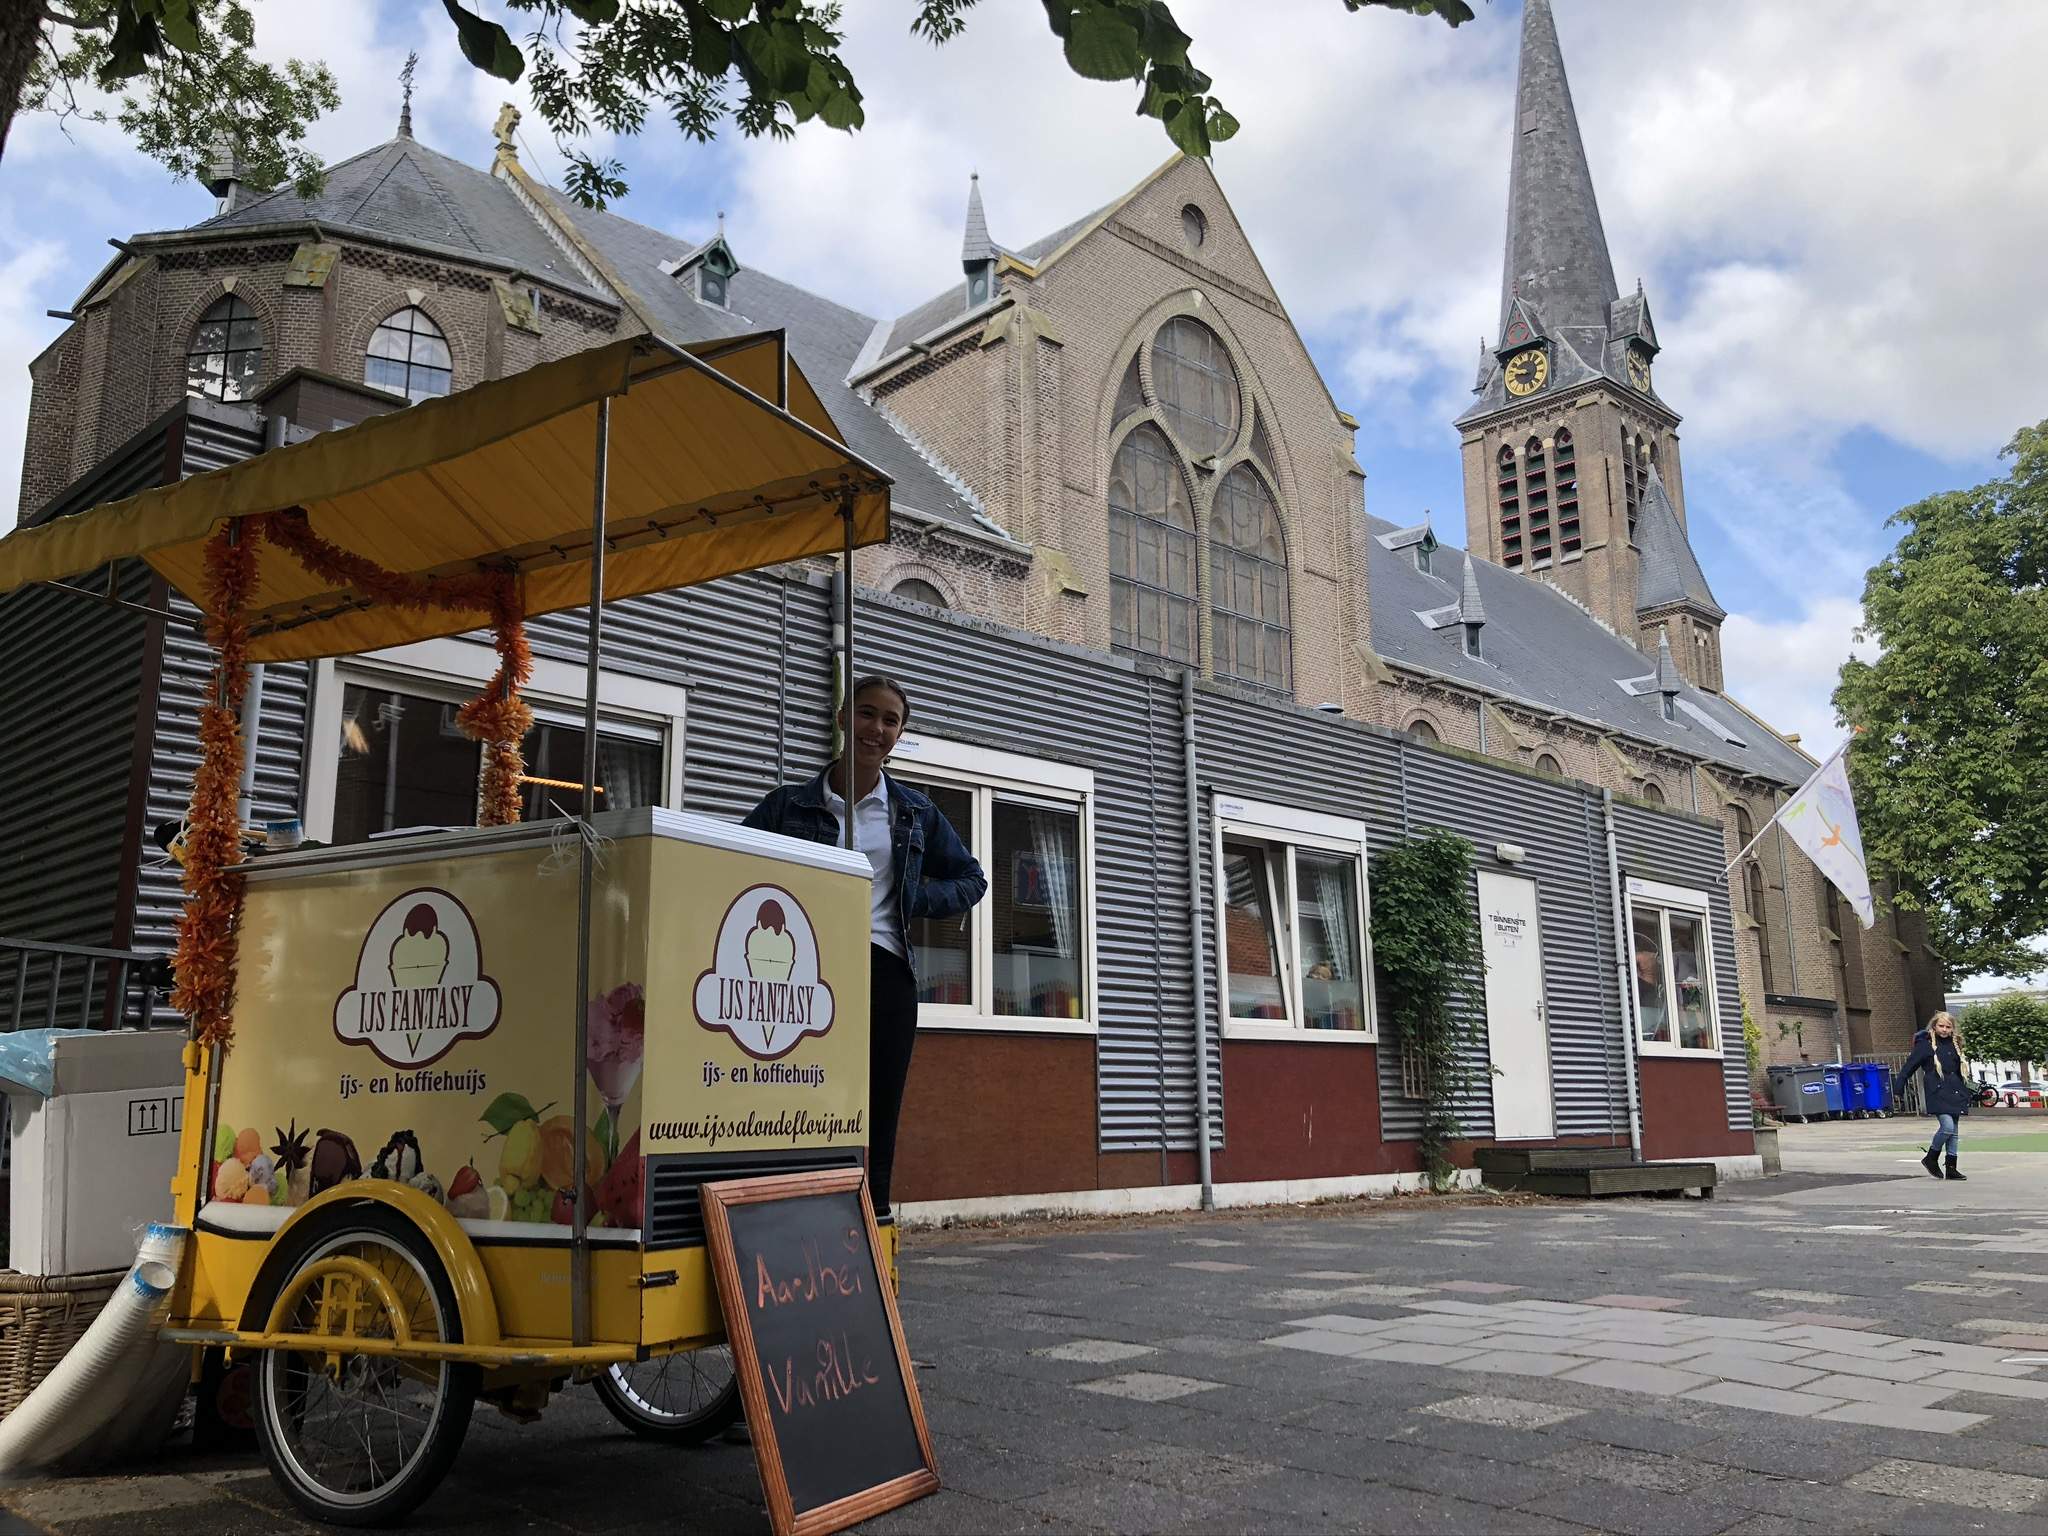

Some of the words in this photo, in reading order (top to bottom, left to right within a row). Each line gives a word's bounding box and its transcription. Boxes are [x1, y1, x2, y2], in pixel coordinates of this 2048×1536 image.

[1494, 915, 1526, 926] BINNENSTE
[1498, 924, 1519, 933] BUITEN
[358, 991, 386, 1033] IJS
[390, 985, 474, 1031] FANTASY
[718, 977, 743, 1020] IJS
[747, 980, 815, 1025] FANTASY
[340, 1074, 363, 1099] ijs-
[369, 1076, 389, 1093] en
[394, 1069, 486, 1095] koffiehuijs
[703, 1061, 726, 1087] ijs-
[730, 1065, 748, 1083] en
[753, 1063, 825, 1088] koffiehuijs
[649, 1109, 863, 1147] www.ijssalondeflorijn.nl
[756, 1225, 863, 1309] Aardbei
[767, 1330, 880, 1414] Vanille
